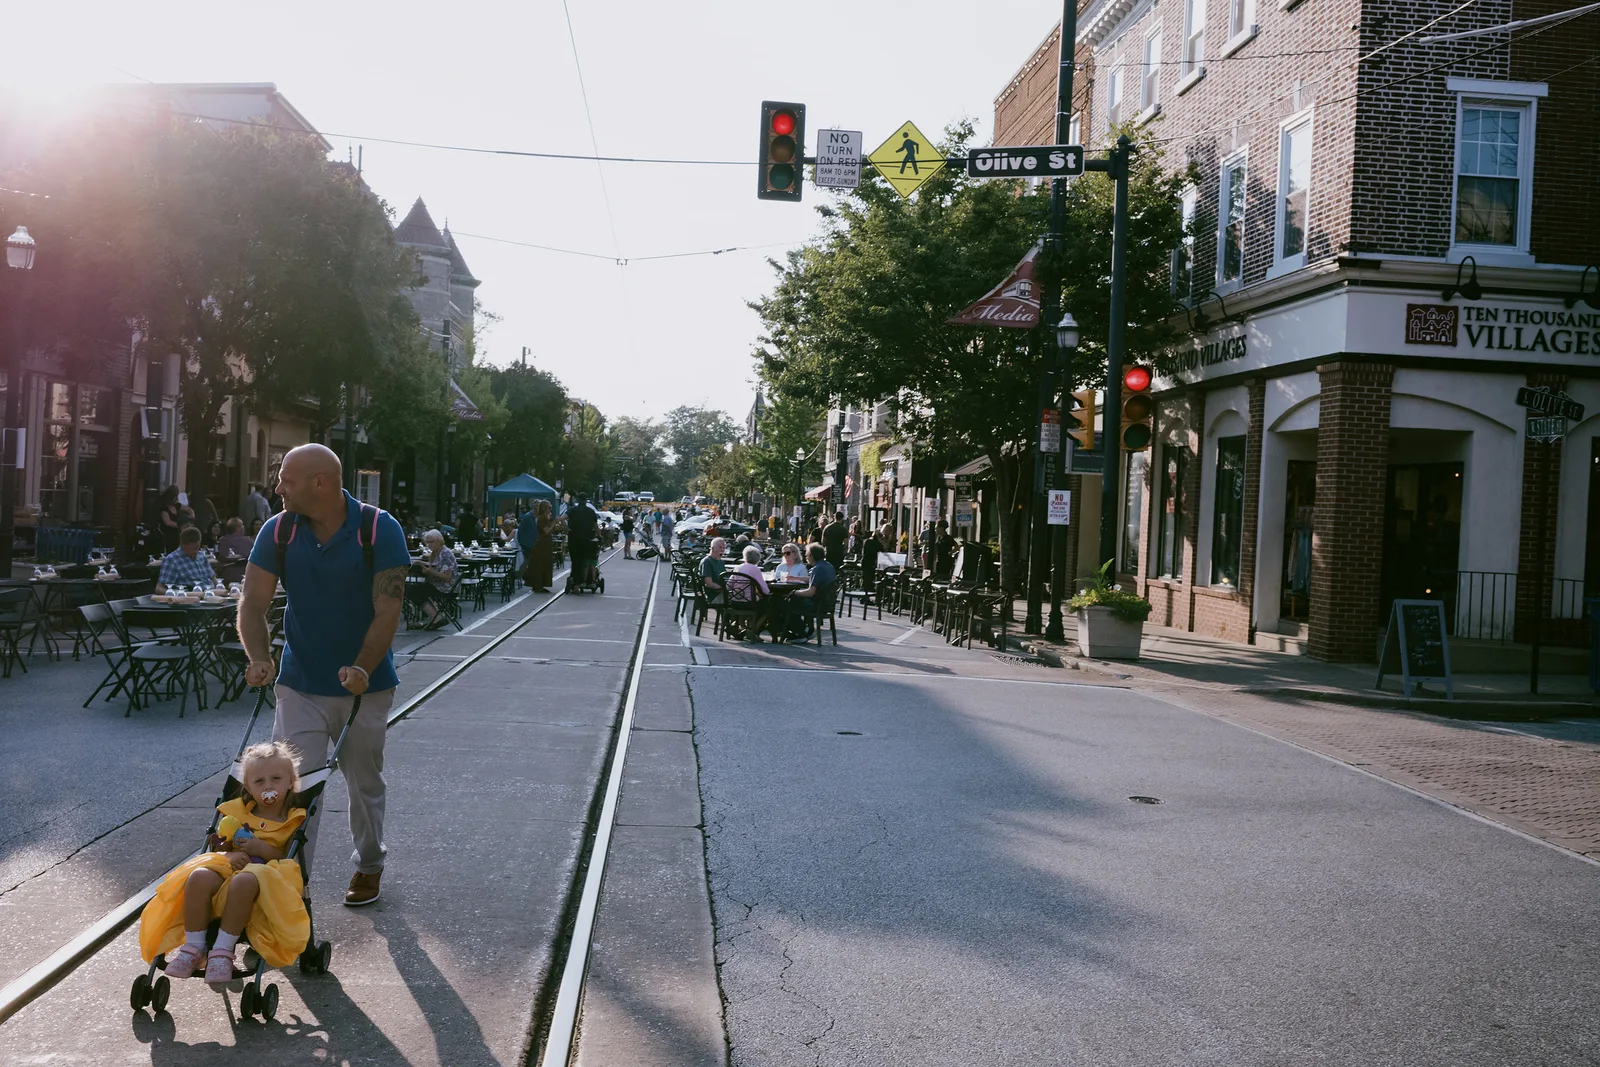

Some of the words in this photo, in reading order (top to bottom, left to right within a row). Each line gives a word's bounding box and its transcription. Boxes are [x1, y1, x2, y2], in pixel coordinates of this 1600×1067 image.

[830, 133, 850, 144] NO
[827, 145, 853, 155] TURN
[820, 156, 834, 166] ON
[838, 157, 857, 167] RED
[975, 152, 1038, 171] Olive
[1048, 150, 1076, 169] St
[834, 168, 842, 176] TO
[837, 178, 856, 186] SUNDAY
[963, 303, 1036, 322] Media
[1463, 306, 1499, 323] TEN
[1503, 308, 1600, 329] THOUSAND
[1463, 324, 1600, 355] VILLAGES
[1200, 334, 1247, 367] VILLAGES
[1532, 392, 1566, 416] OLIVE
[1536, 418, 1556, 435] STATE
[1054, 493, 1064, 502] NO
